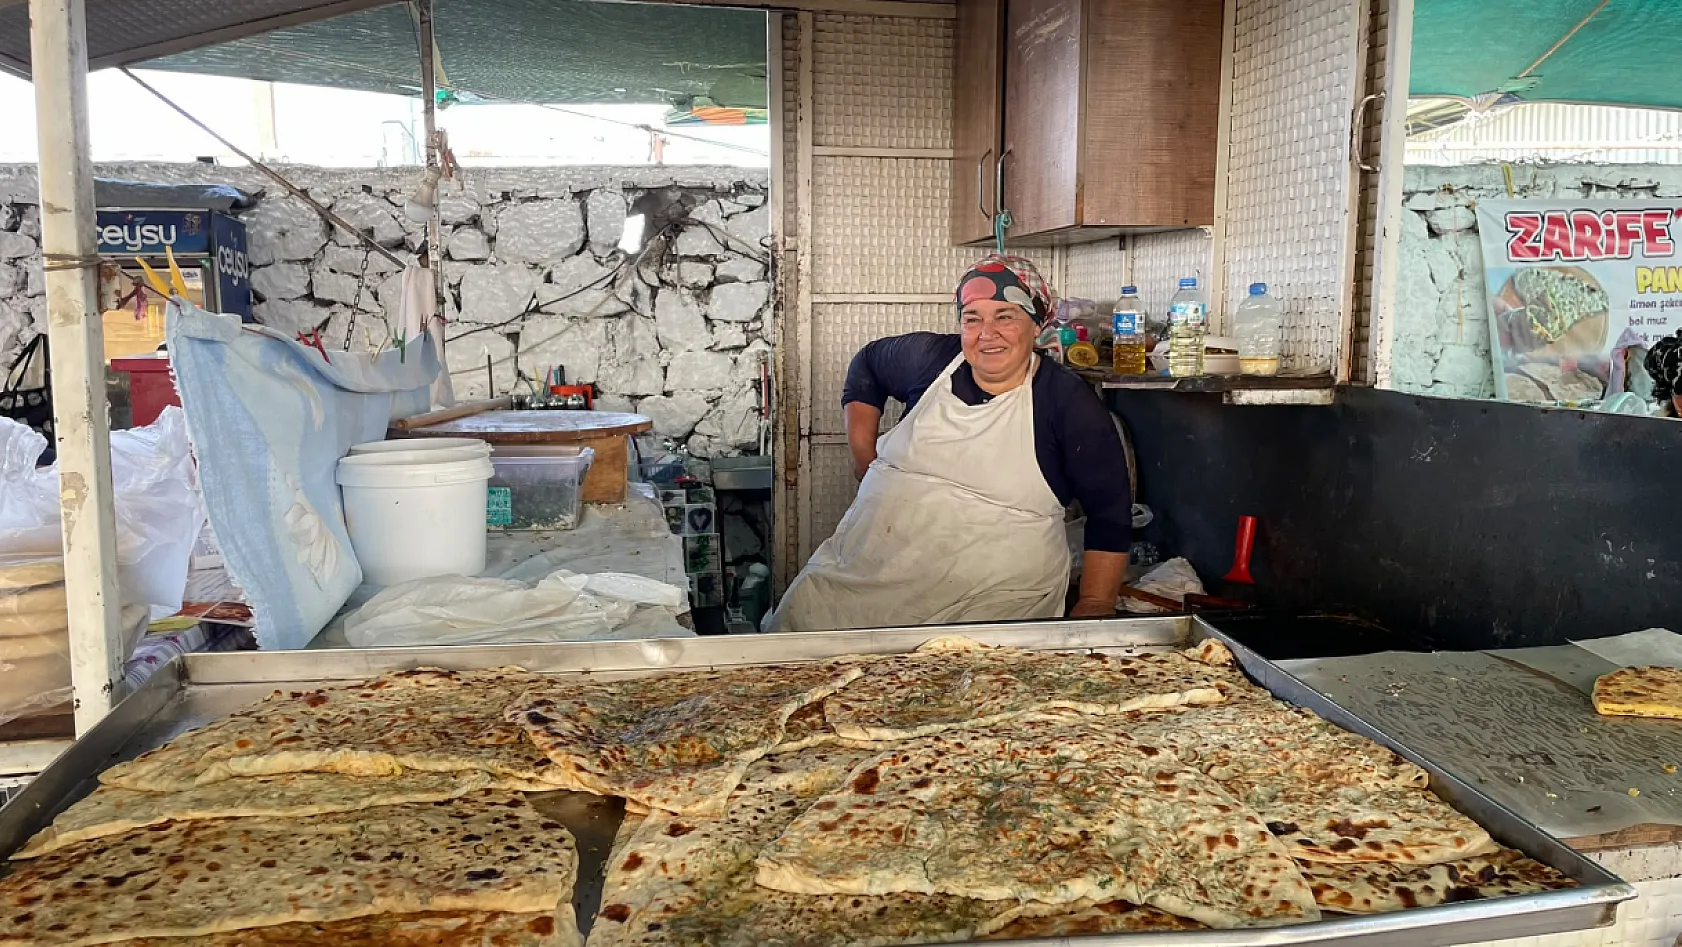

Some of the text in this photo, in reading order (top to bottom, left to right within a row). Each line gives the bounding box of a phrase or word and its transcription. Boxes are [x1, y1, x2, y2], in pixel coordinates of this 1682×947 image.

[219, 245, 249, 287] ceysu
[1629, 299, 1657, 309] limon
[1646, 317, 1667, 325] muz
